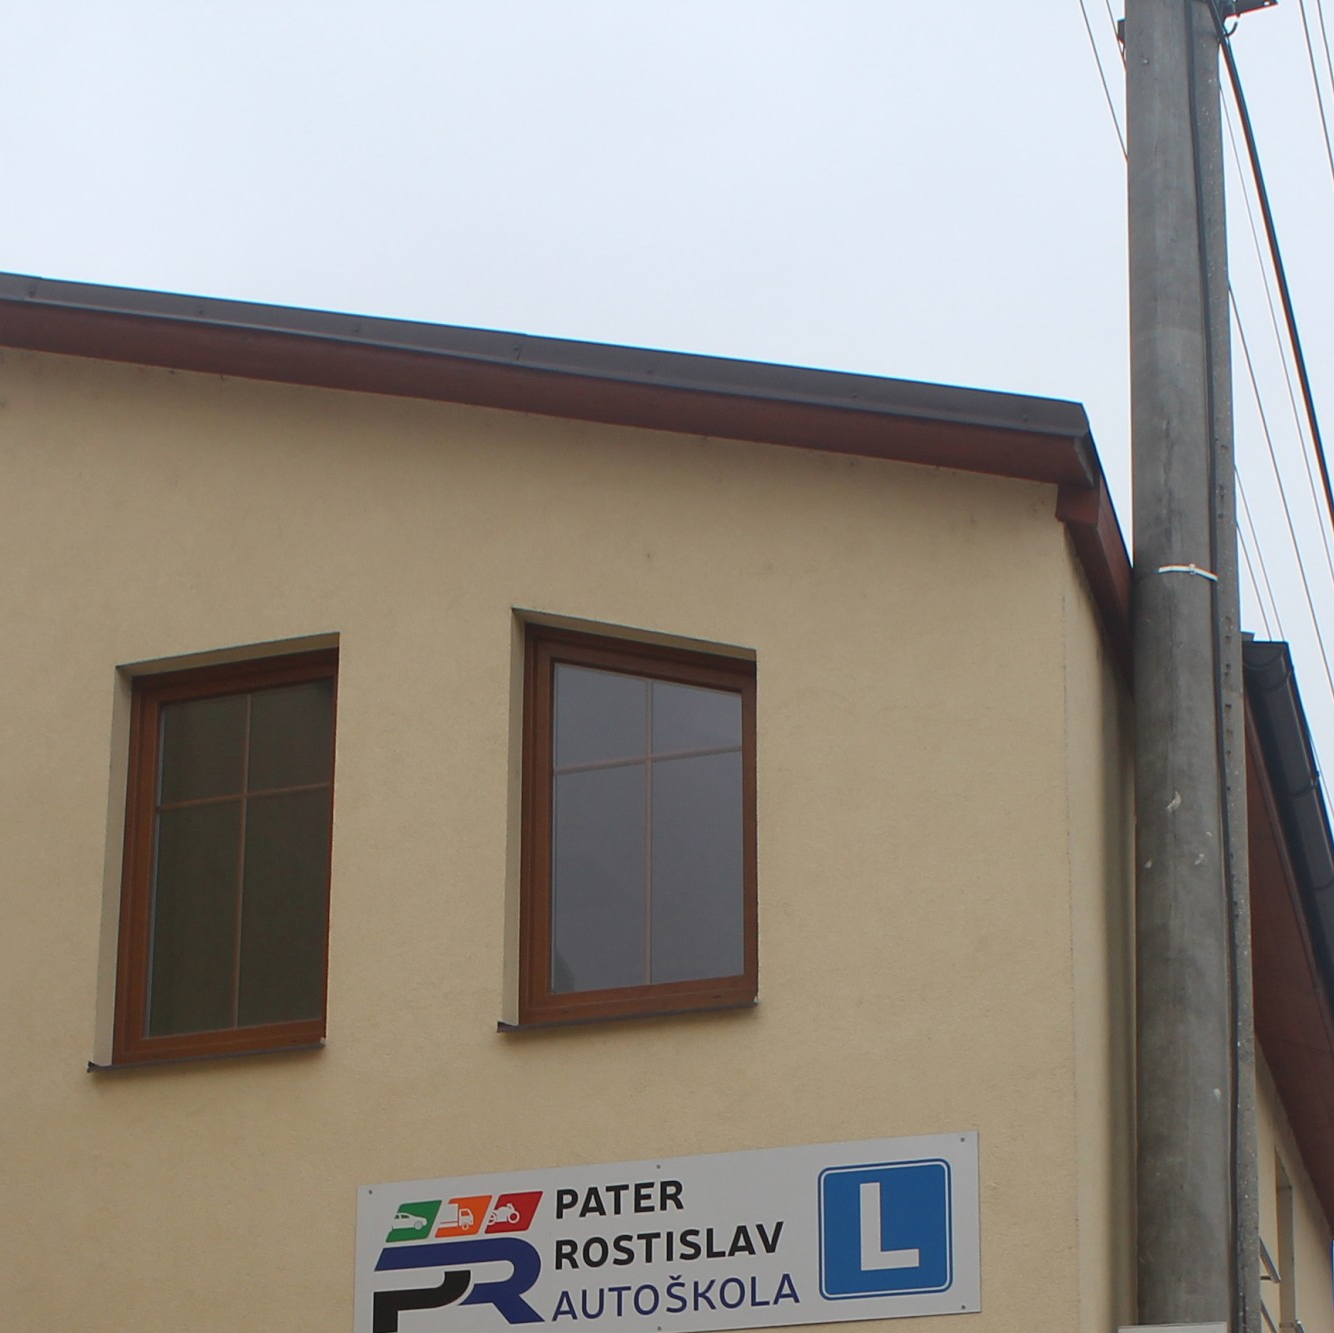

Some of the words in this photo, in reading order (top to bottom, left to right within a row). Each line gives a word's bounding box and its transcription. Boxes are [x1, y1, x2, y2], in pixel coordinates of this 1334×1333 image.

[556, 1180, 683, 1219] PATER
[555, 1222, 784, 1270] ROSTISLAV
[859, 1182, 920, 1271] L
[551, 1273, 800, 1322] AUTOŠKOLA
